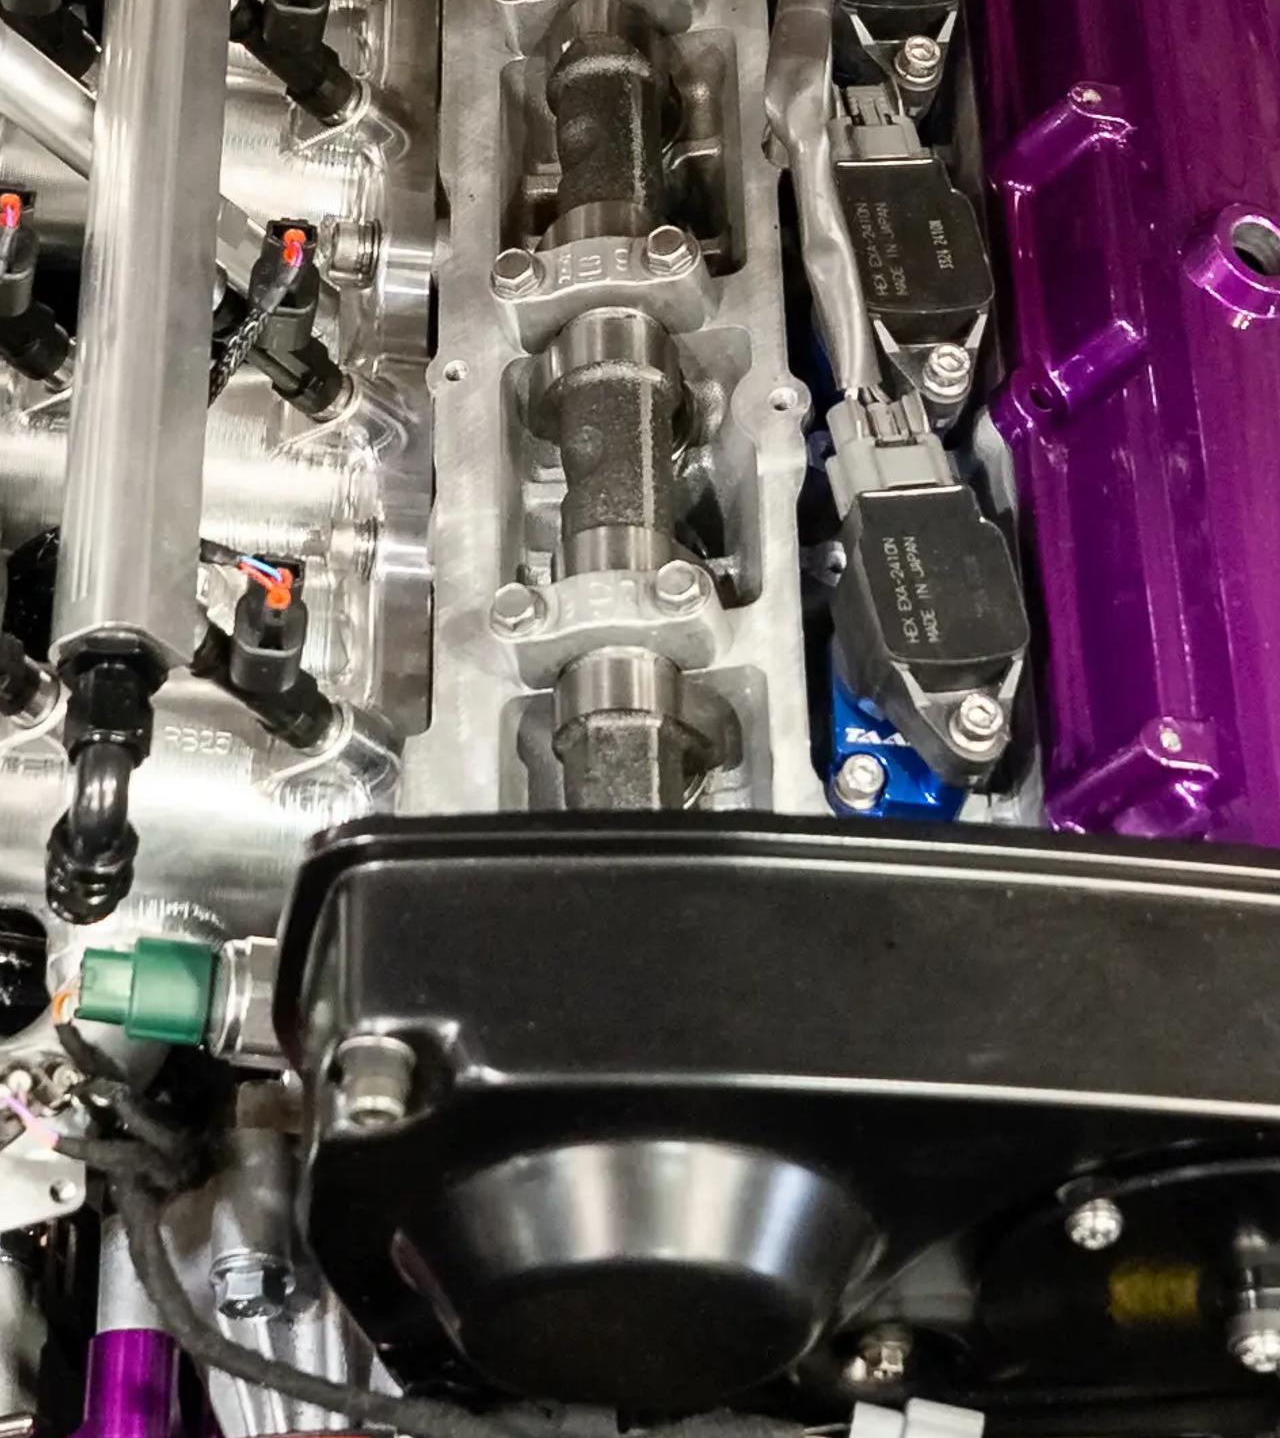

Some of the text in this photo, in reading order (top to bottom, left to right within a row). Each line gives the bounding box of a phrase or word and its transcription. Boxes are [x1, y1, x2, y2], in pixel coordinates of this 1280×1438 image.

[875, 201, 910, 296] MADE IN JAPAN
[902, 535, 941, 643] MADE IN JAPAN
[901, 616, 921, 644] HEX
[844, 727, 909, 746] TAA
